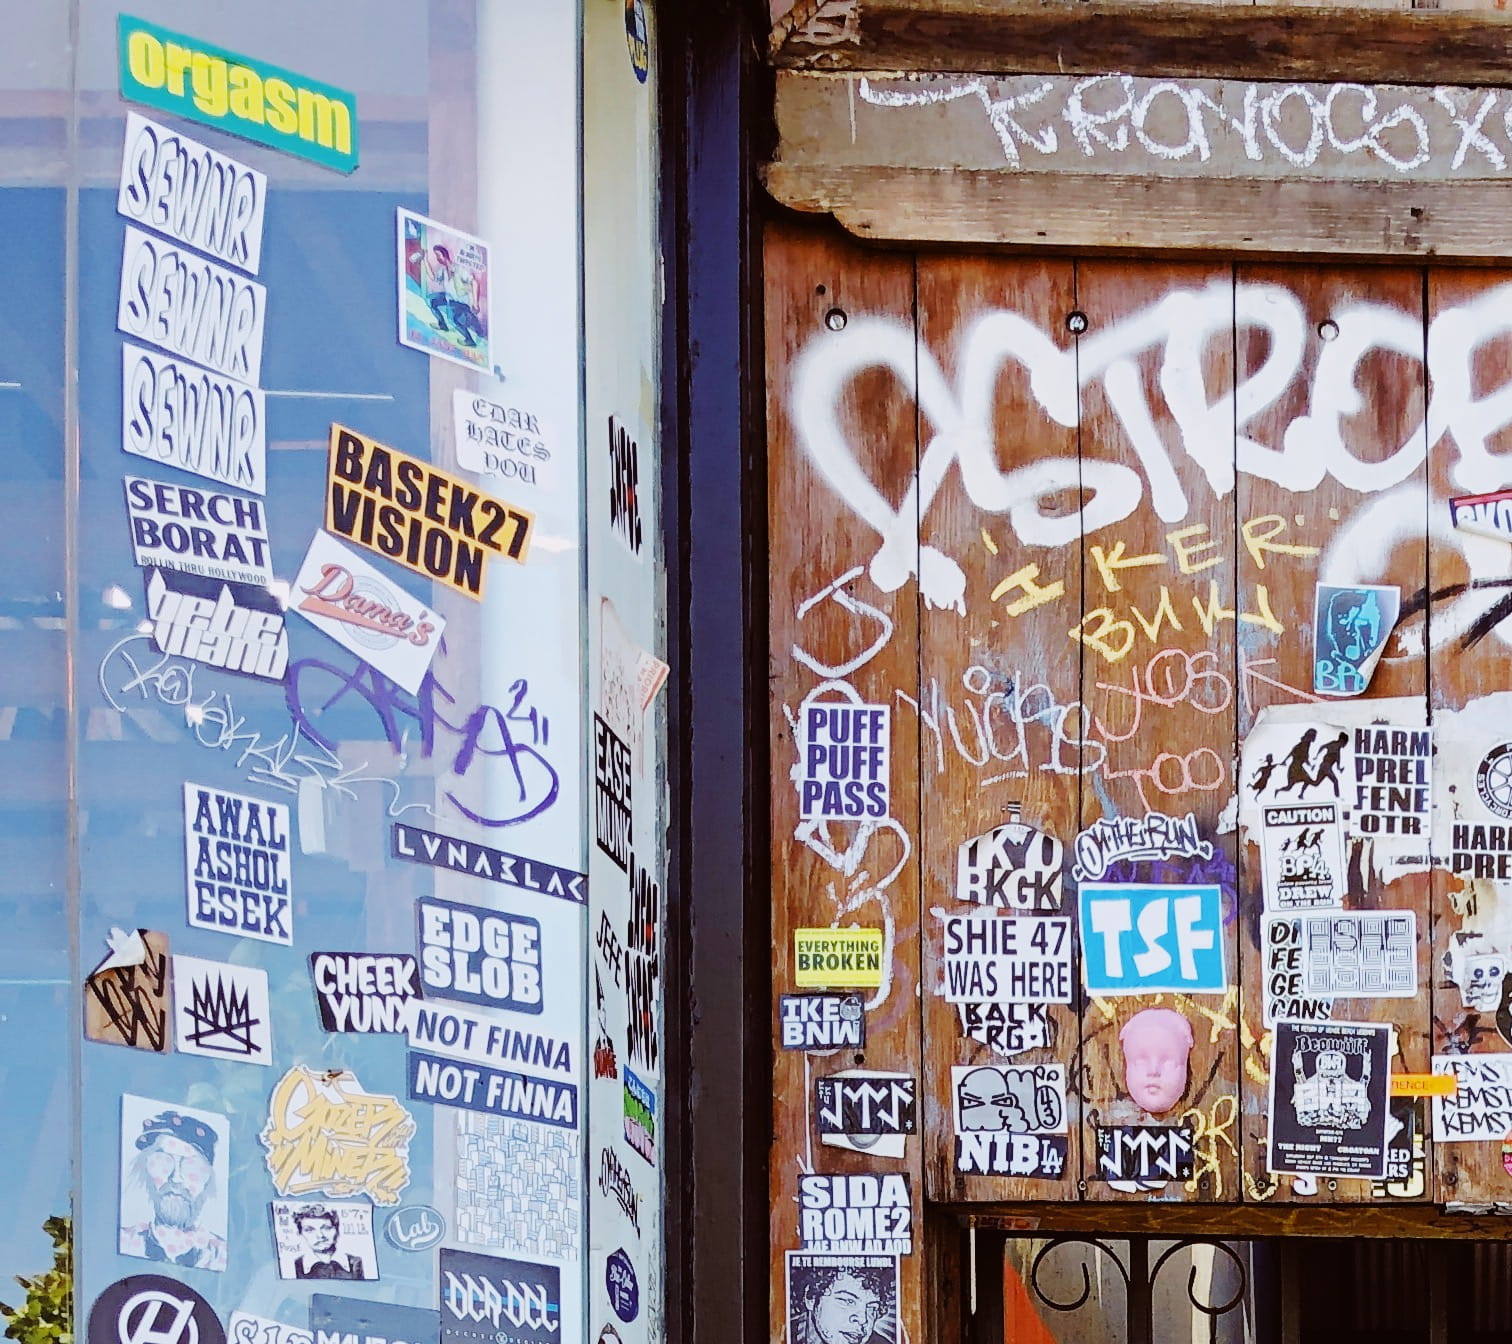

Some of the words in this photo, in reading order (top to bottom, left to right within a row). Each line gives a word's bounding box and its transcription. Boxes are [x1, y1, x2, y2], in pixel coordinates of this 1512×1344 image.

[128, 30, 352, 155] orgasm
[127, 125, 257, 263] SEWNR
[126, 239, 256, 374] SEWNR
[128, 356, 257, 487] SEWNR
[466, 421, 551, 462] HATES
[484, 453, 538, 486] YOU
[130, 479, 261, 531] SERCH
[335, 430, 529, 560] BASEK27
[136, 517, 267, 567] BORAT
[330, 487, 485, 594] VISION
[301, 563, 434, 646] Dama's
[808, 707, 884, 744] PUFF
[1354, 728, 1428, 755] HARM
[597, 720, 630, 798] EASE
[808, 745, 884, 781] PUFF
[1355, 758, 1429, 784] PREL
[193, 792, 286, 849] AWAL
[802, 781, 886, 817] PASS
[1267, 809, 1334, 824] CAUTION
[597, 800, 631, 871] MUNK
[195, 837, 288, 890] ASHOL
[197, 885, 290, 936] ESEK
[423, 906, 539, 965] EDGE
[798, 940, 879, 955] EVERYTHING
[947, 919, 1017, 956] SHIE
[1031, 922, 1067, 956] 47
[1090, 896, 1214, 980] TSF
[315, 956, 414, 999] CHEEK
[423, 949, 542, 1004] SLOB
[798, 954, 880, 972] BROKEN
[948, 961, 998, 997] WAS
[1011, 962, 1068, 999] HERE
[784, 998, 840, 1021] IKE
[784, 1022, 860, 1047] BNW
[417, 1009, 473, 1049] NOT
[486, 1026, 571, 1073] FINNA
[417, 1066, 473, 1102] NOT
[486, 1080, 574, 1124] FINNA
[801, 1176, 910, 1208] SIDA
[803, 1208, 910, 1240] ROME2
